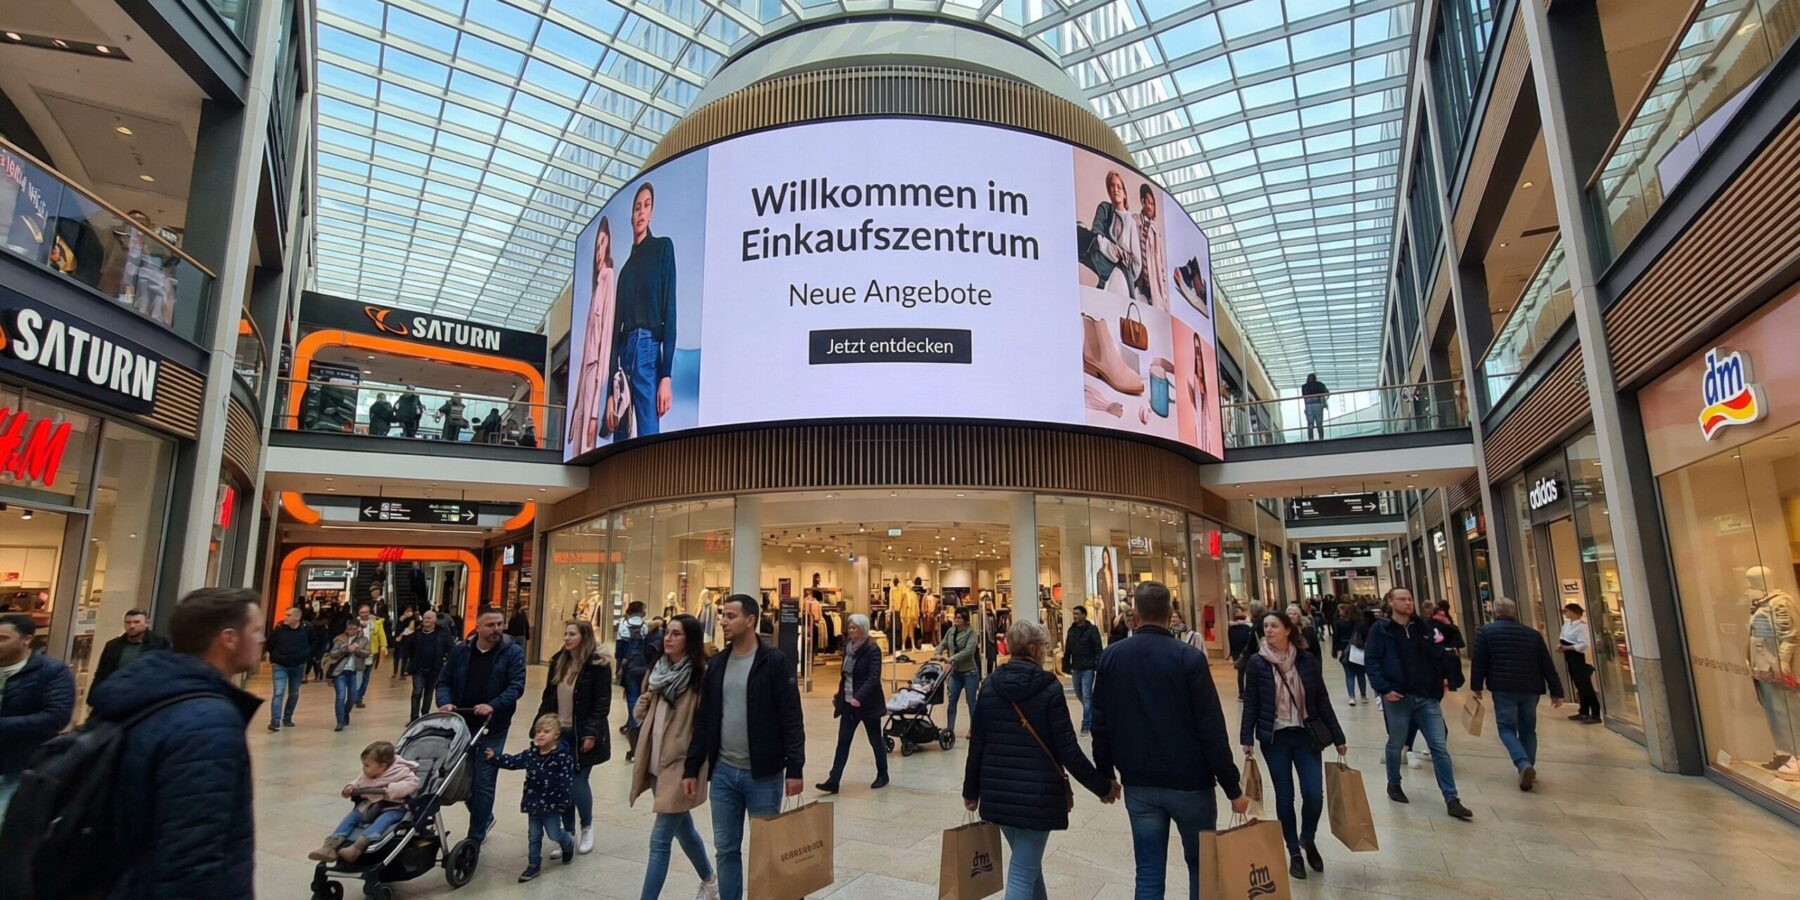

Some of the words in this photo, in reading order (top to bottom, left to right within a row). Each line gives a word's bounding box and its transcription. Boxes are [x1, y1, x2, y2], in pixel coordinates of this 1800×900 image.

[752, 178, 977, 217] Willkommen
[988, 180, 1028, 217] im
[742, 219, 1039, 262] Einkaufszentrum
[789, 282, 856, 307] Neue
[864, 280, 992, 308] Angebote
[412, 316, 501, 351] SATURN
[826, 338, 866, 355] Jetzt
[869, 337, 954, 355] entdecken
[13, 308, 157, 402] SATURN
[1704, 353, 1743, 406] dm
[1530, 477, 1558, 510] adidas
[973, 850, 990, 867] dm
[1249, 863, 1270, 887] dm
